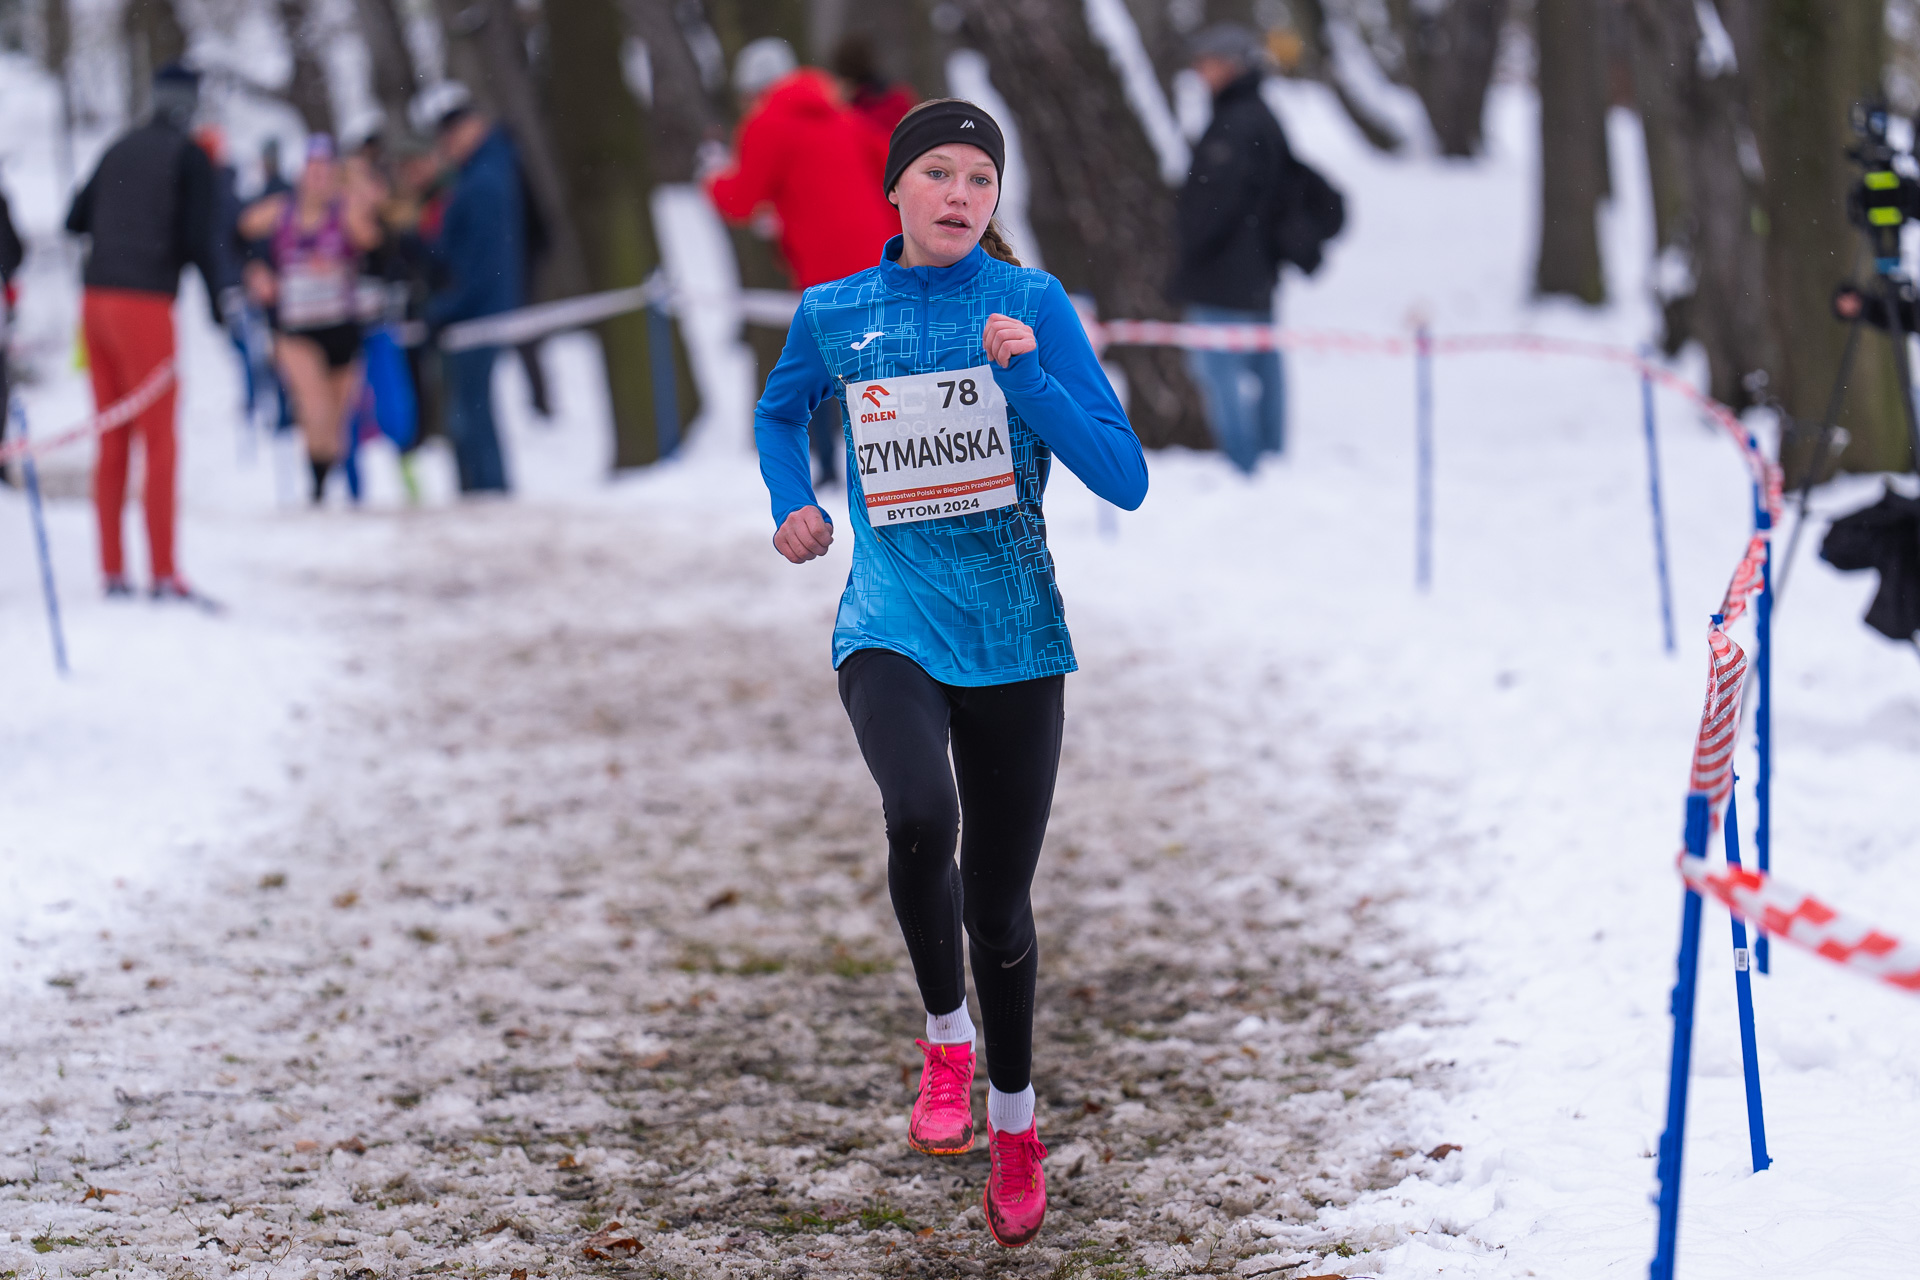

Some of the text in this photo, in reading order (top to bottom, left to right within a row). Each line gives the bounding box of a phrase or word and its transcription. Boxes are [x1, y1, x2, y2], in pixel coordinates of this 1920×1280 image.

[937, 378, 979, 409] 78
[861, 410, 897, 424] ORLEN
[858, 427, 1005, 476] SZYMAŃSKA
[877, 492, 916, 502] Mistrzostwa
[916, 488, 936, 497] Polski
[943, 483, 970, 494] Biegach
[970, 476, 1012, 490] Przełajowych
[887, 498, 980, 521] BYTOM 2024
